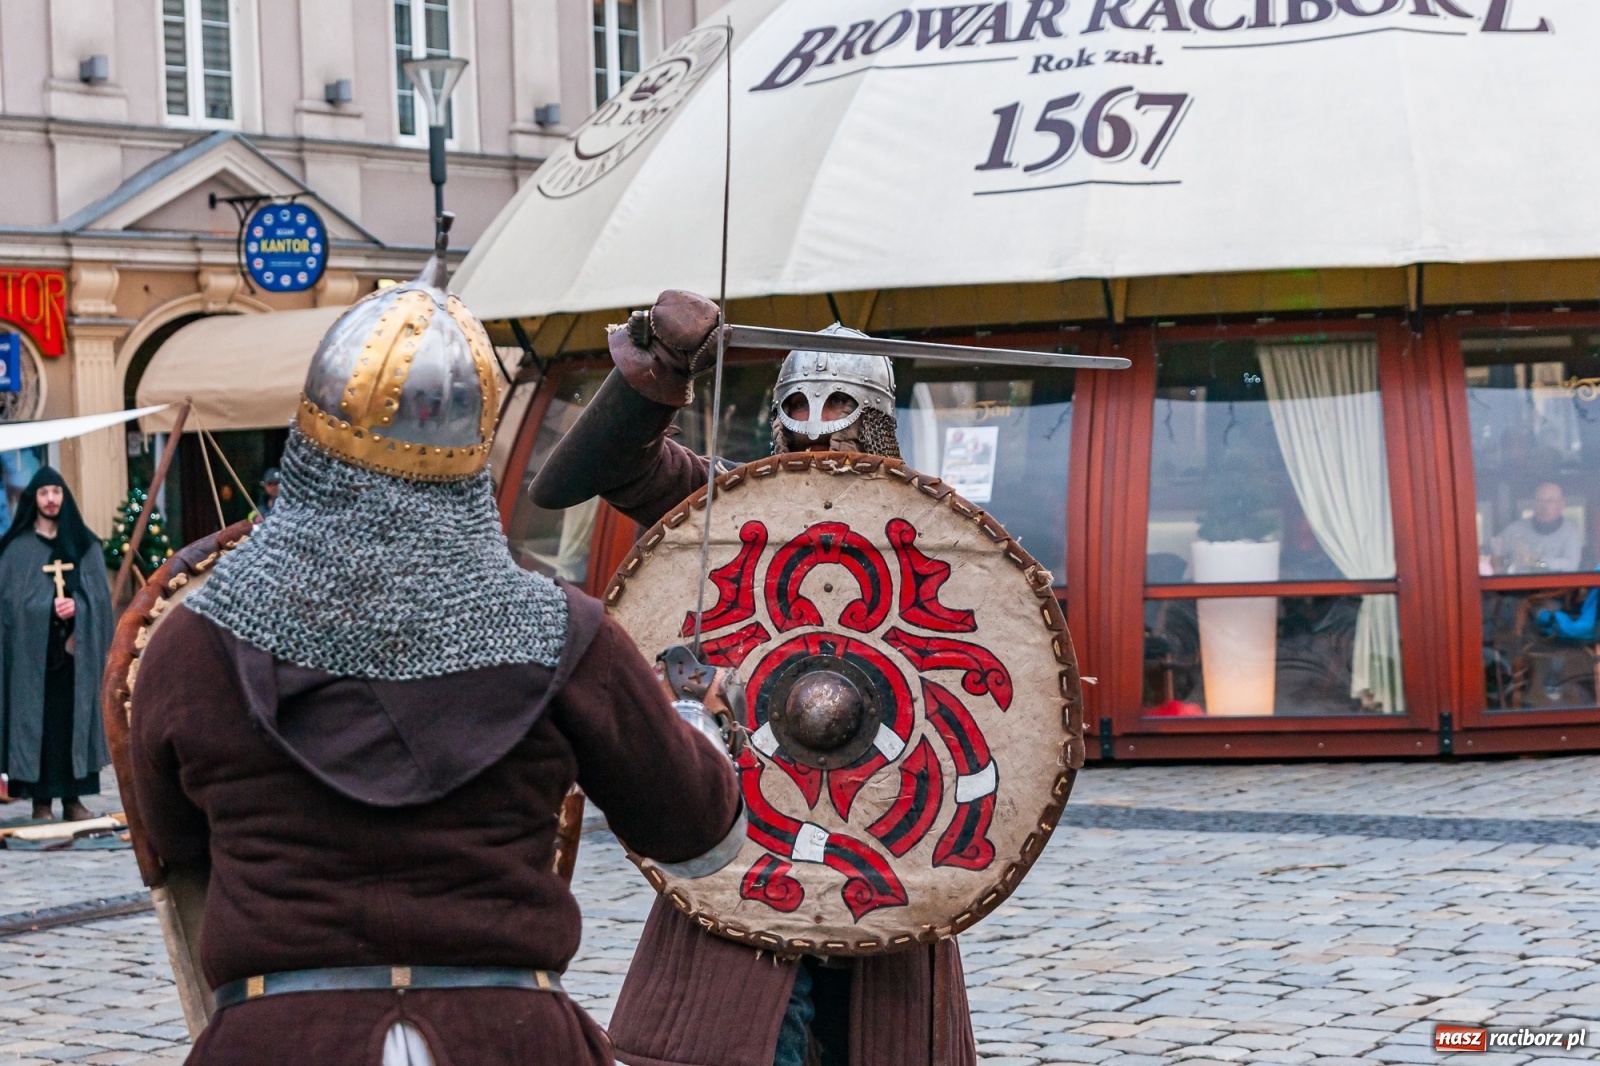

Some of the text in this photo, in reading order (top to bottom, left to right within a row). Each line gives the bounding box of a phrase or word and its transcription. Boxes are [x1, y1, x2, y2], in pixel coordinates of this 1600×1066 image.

[748, 0, 1066, 92] BROWAR
[1028, 44, 1163, 74] Rok zał.
[975, 85, 1192, 174] 1567
[260, 238, 309, 254] KANTOR
